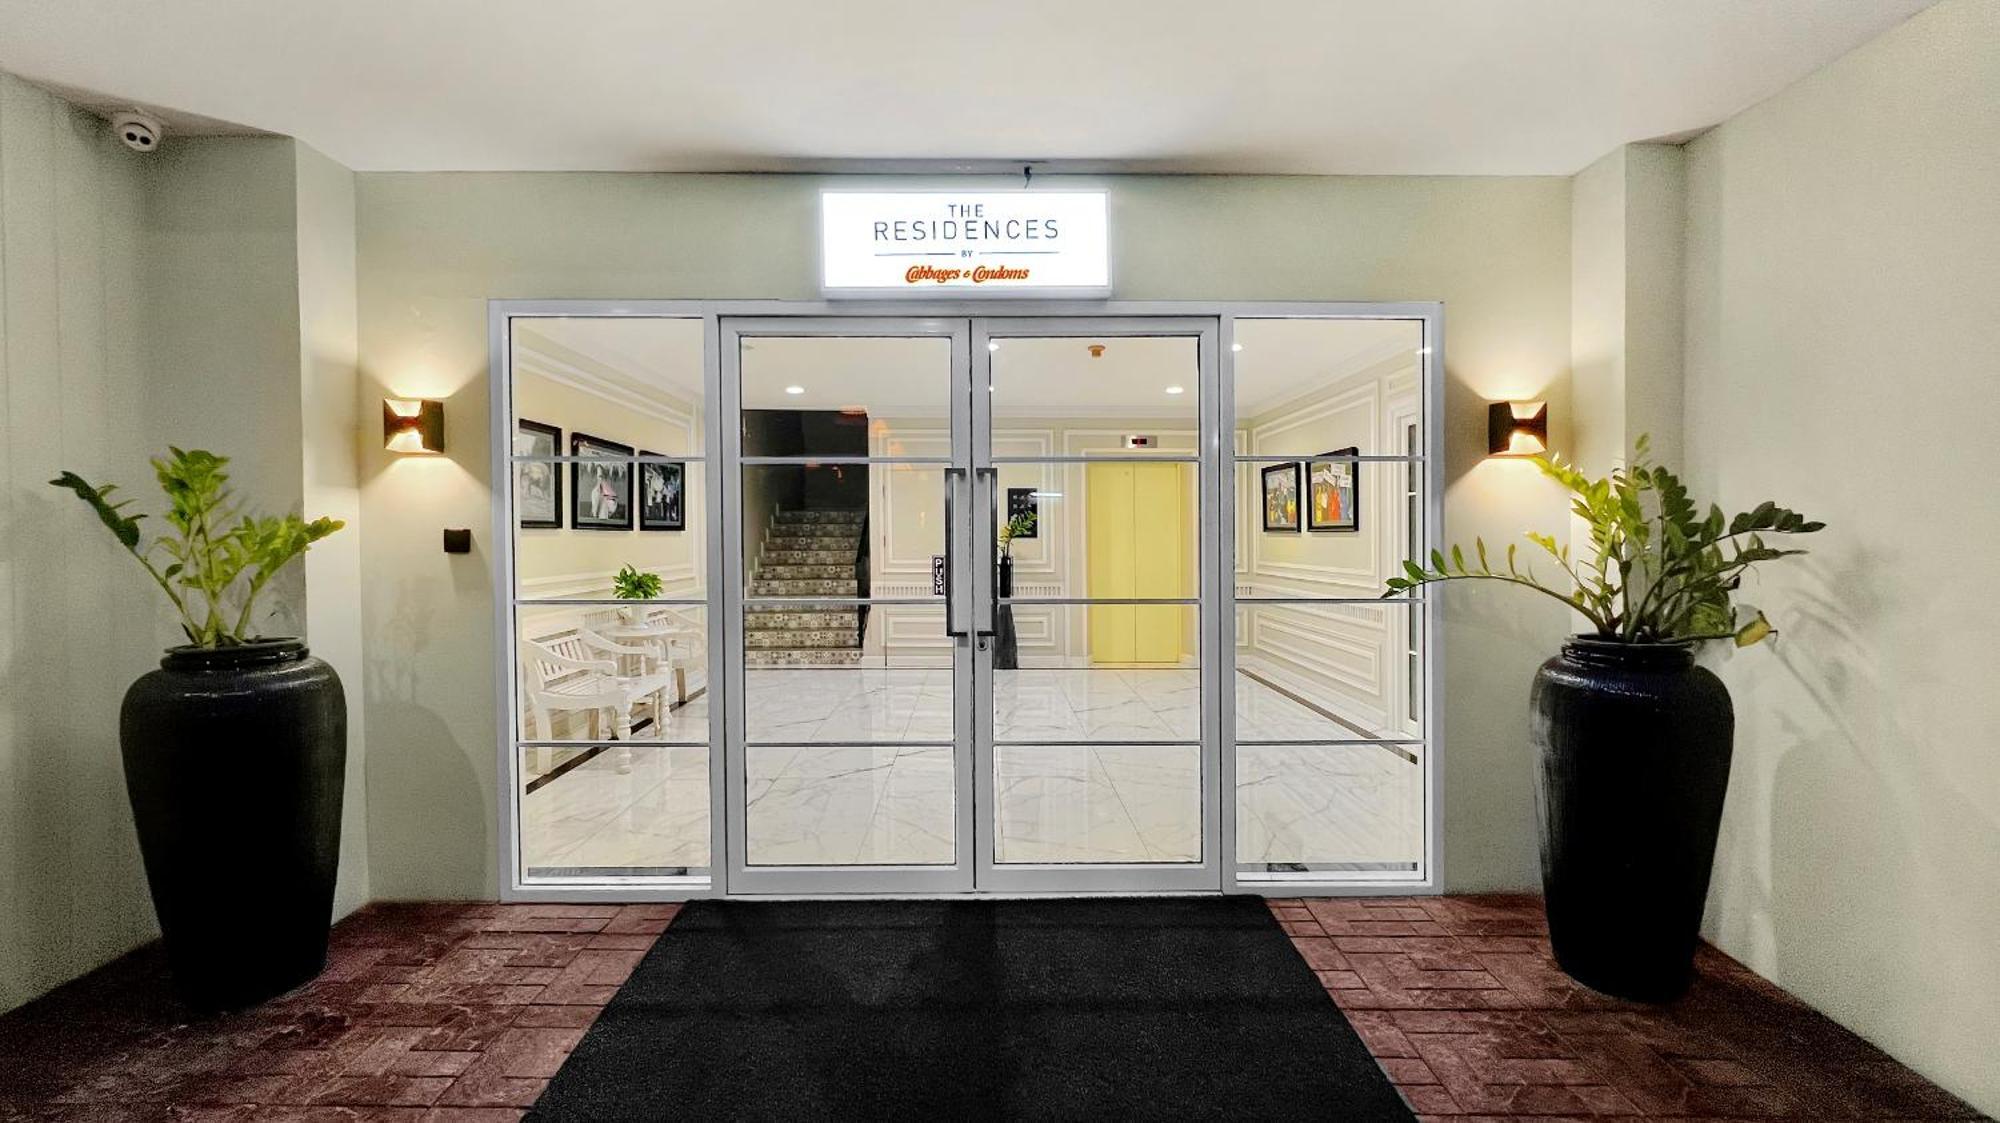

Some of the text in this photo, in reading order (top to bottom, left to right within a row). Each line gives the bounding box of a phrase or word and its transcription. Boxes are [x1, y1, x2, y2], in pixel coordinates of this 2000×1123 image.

[947, 203, 984, 218] THE
[873, 219, 1059, 241] RESIDENCES
[960, 249, 974, 258] BY
[904, 264, 962, 284] Cabbages
[971, 264, 1031, 284] Condoms
[935, 558, 944, 594] PUSH
